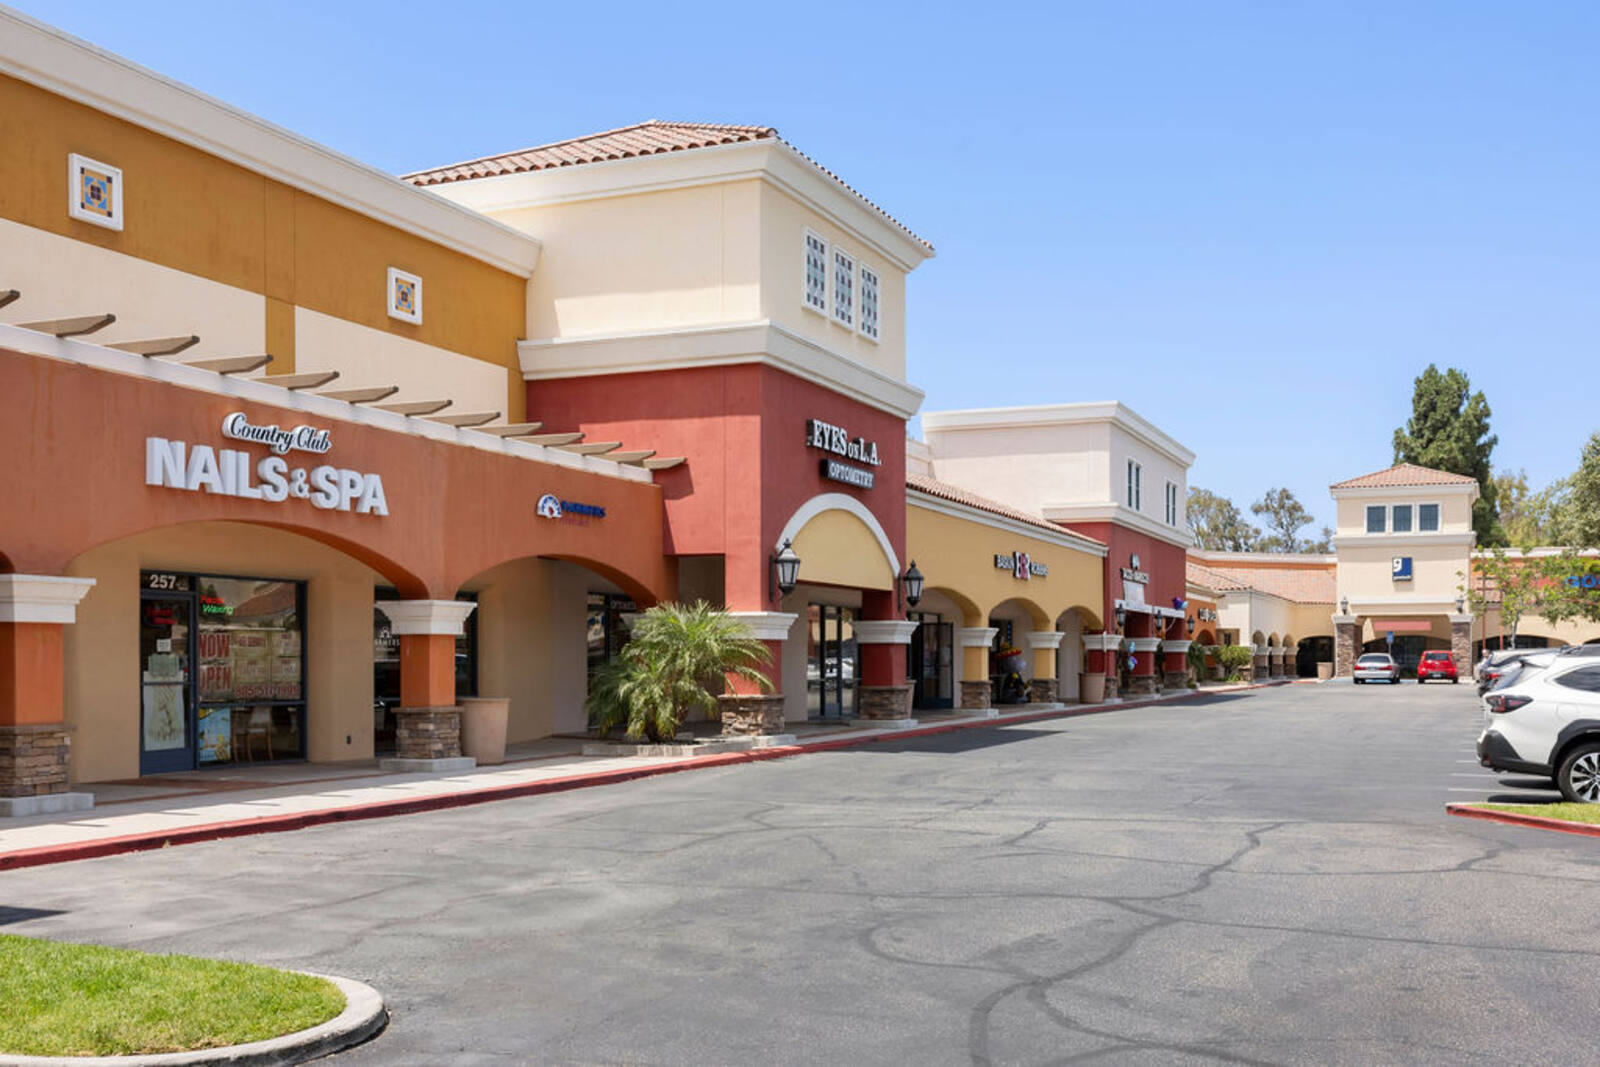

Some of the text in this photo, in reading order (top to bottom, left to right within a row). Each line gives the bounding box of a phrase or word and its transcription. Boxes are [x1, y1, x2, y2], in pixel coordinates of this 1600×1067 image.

[226, 412, 330, 453] Country Club
[811, 418, 848, 456] EYES
[145, 436, 389, 517] NAILS & SPA
[828, 461, 875, 489] OPTOMETRY
[149, 574, 176, 589] 257
[199, 633, 230, 659] NOW
